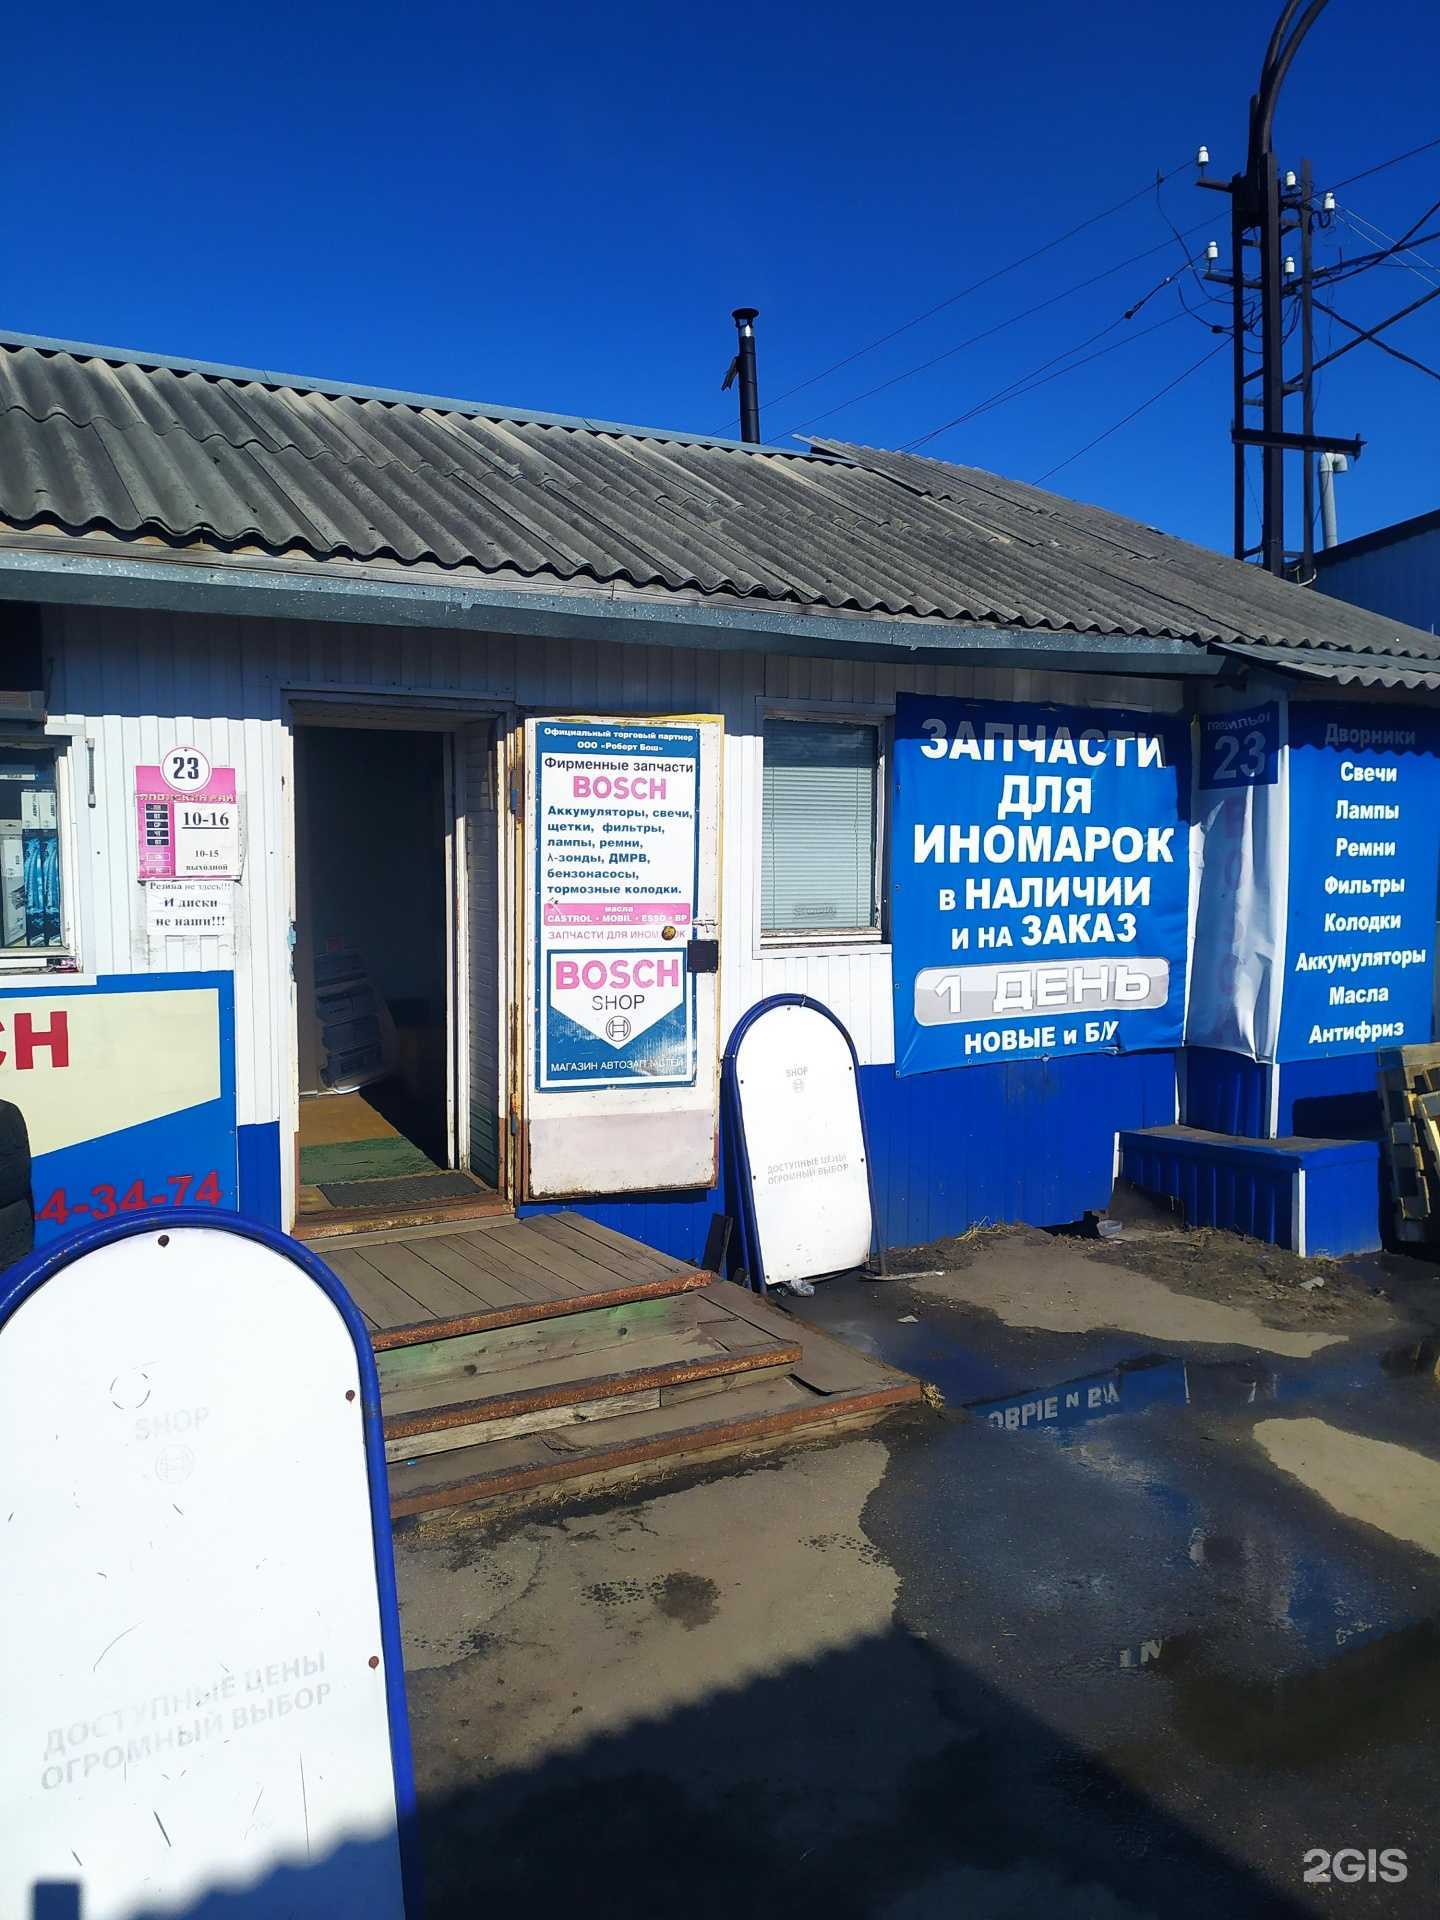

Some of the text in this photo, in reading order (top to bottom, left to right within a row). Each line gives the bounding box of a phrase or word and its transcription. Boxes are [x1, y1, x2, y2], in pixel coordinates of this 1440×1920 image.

[544, 728, 693, 742] Официальный торговый партнер
[920, 719, 1167, 768] ЗАПЧАСТИ
[1325, 723, 1416, 748] Дворники
[544, 757, 694, 773] Фирменные запчасти
[1213, 731, 1266, 780] 23
[173, 757, 199, 779] 23
[1340, 761, 1397, 783] Свечи
[573, 775, 667, 800] BOSCH
[997, 775, 1092, 820] ДЛЯ
[183, 812, 229, 826] 10-16
[547, 806, 693, 820] Аккумуляторы, свечи,
[1336, 800, 1400, 820] Лампы
[547, 823, 665, 834] щетки, фильтры,
[547, 838, 643, 849] лампы, ремни,
[913, 824, 1175, 864] ИНОМАРОК
[1336, 838, 1396, 857] Ремни
[195, 850, 219, 858] 10-15
[608, 853, 651, 864] ДМРВ,
[186, 863, 228, 871] выходной
[547, 869, 639, 880] бензонасосы,
[547, 885, 682, 895] тормозные колодки.
[965, 876, 1151, 910] НАЛИЧИИ
[1324, 875, 1405, 897] Фильтры
[178, 898, 218, 908] диски
[156, 917, 171, 926] не
[547, 914, 687, 923] CASTROL MOBIL ESSO BP
[1324, 912, 1401, 933] Колодки
[548, 930, 604, 940] ЗАПЧАСТИ
[607, 930, 627, 940] ДЛЯ
[978, 925, 1014, 949] НА
[1021, 913, 1137, 946] ЗАКАЗ
[1295, 949, 1426, 972] Аккумуляторы
[555, 959, 679, 990] BOSCH
[935, 965, 1151, 1014] 1 ДЕНЬ
[1329, 985, 1389, 1005] Масла
[592, 994, 645, 1011] SHOP
[964, 1026, 1056, 1055] НОВЫЕ
[1064, 1029, 1077, 1045] и
[1308, 1021, 1404, 1044] Антифриз
[551, 1062, 598, 1072] МАГАЗИН
[786, 1066, 808, 1078] SHOP
[768, 1156, 819, 1176] ДОСТУПНЫЕ
[768, 1163, 848, 1184] ОГРОМНЫЙ ВЫБОР
[136, 1406, 209, 1440] SHOP
[43, 1651, 327, 1761] ДОСТУПНЫЕ ЦЕНЫ
[41, 1682, 331, 1790] ОГРОМНЫЙ ВЫБОР
